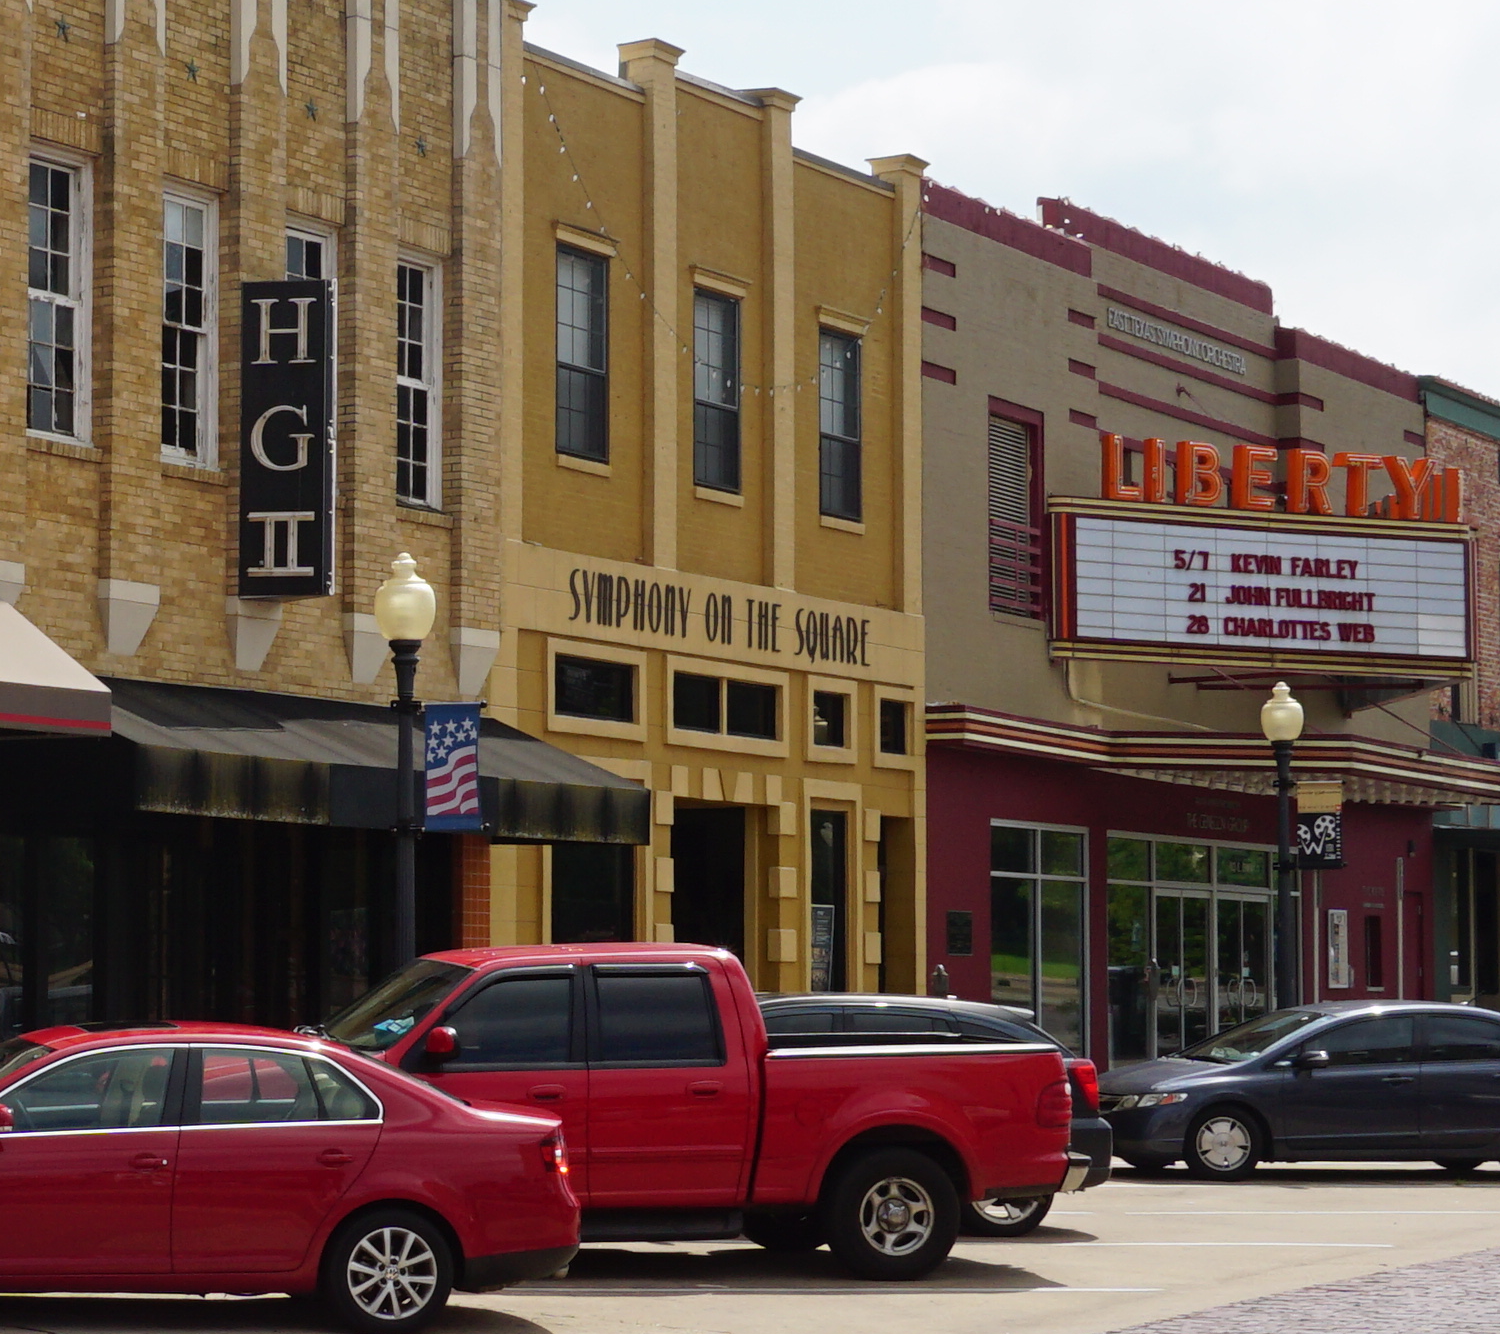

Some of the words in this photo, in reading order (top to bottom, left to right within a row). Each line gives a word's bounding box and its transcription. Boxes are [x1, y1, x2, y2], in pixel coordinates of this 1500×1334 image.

[1105, 307, 1127, 334] EAST
[1129, 315, 1154, 343] TEXAS
[1202, 343, 1247, 375] ORCHESTRA
[1101, 433, 1440, 519] LIBERTY
[1173, 549, 1209, 571] 5/7
[1231, 553, 1282, 576] KEVIN
[1290, 556, 1359, 580] FARLEY
[568, 568, 692, 639] SYMPHONY
[746, 599, 782, 653] THE
[793, 608, 871, 667] SQUARE
[1187, 582, 1206, 603] 21
[1225, 585, 1271, 607] JOHN
[1275, 587, 1376, 613] FULLBRIGHT
[1186, 614, 1209, 635] 28
[1223, 616, 1332, 642] CHARLOTTES
[1337, 622, 1375, 644] WEB
